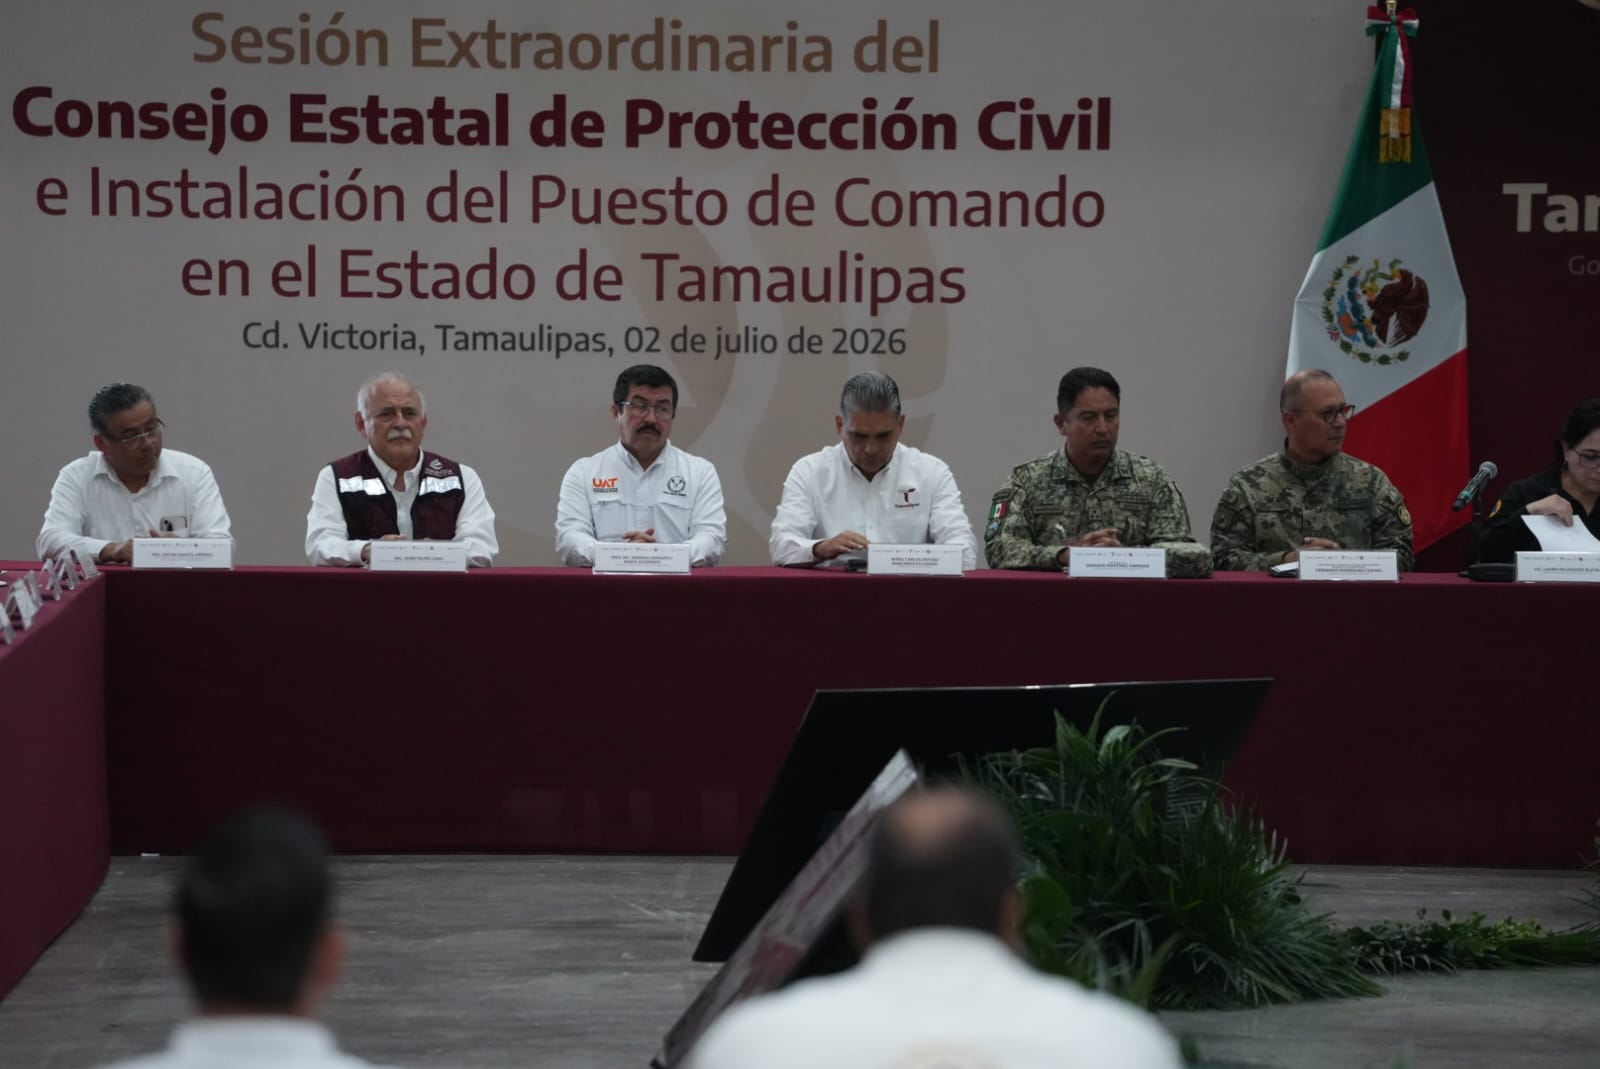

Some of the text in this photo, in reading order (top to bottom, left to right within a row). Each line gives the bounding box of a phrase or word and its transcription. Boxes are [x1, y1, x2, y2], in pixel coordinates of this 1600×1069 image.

[192, 12, 940, 73] Sesión Extraordinaria del
[12, 86, 1112, 155] Consejo Estatal de Protección Civil
[36, 165, 1106, 229] e Instalación del Puesto de Comando
[181, 244, 967, 317] en el Estado de Tamaulipas
[242, 321, 907, 361] Cd. Victoria, Tamaulipas, 02 de julio de 2026
[592, 476, 619, 488] UAT
